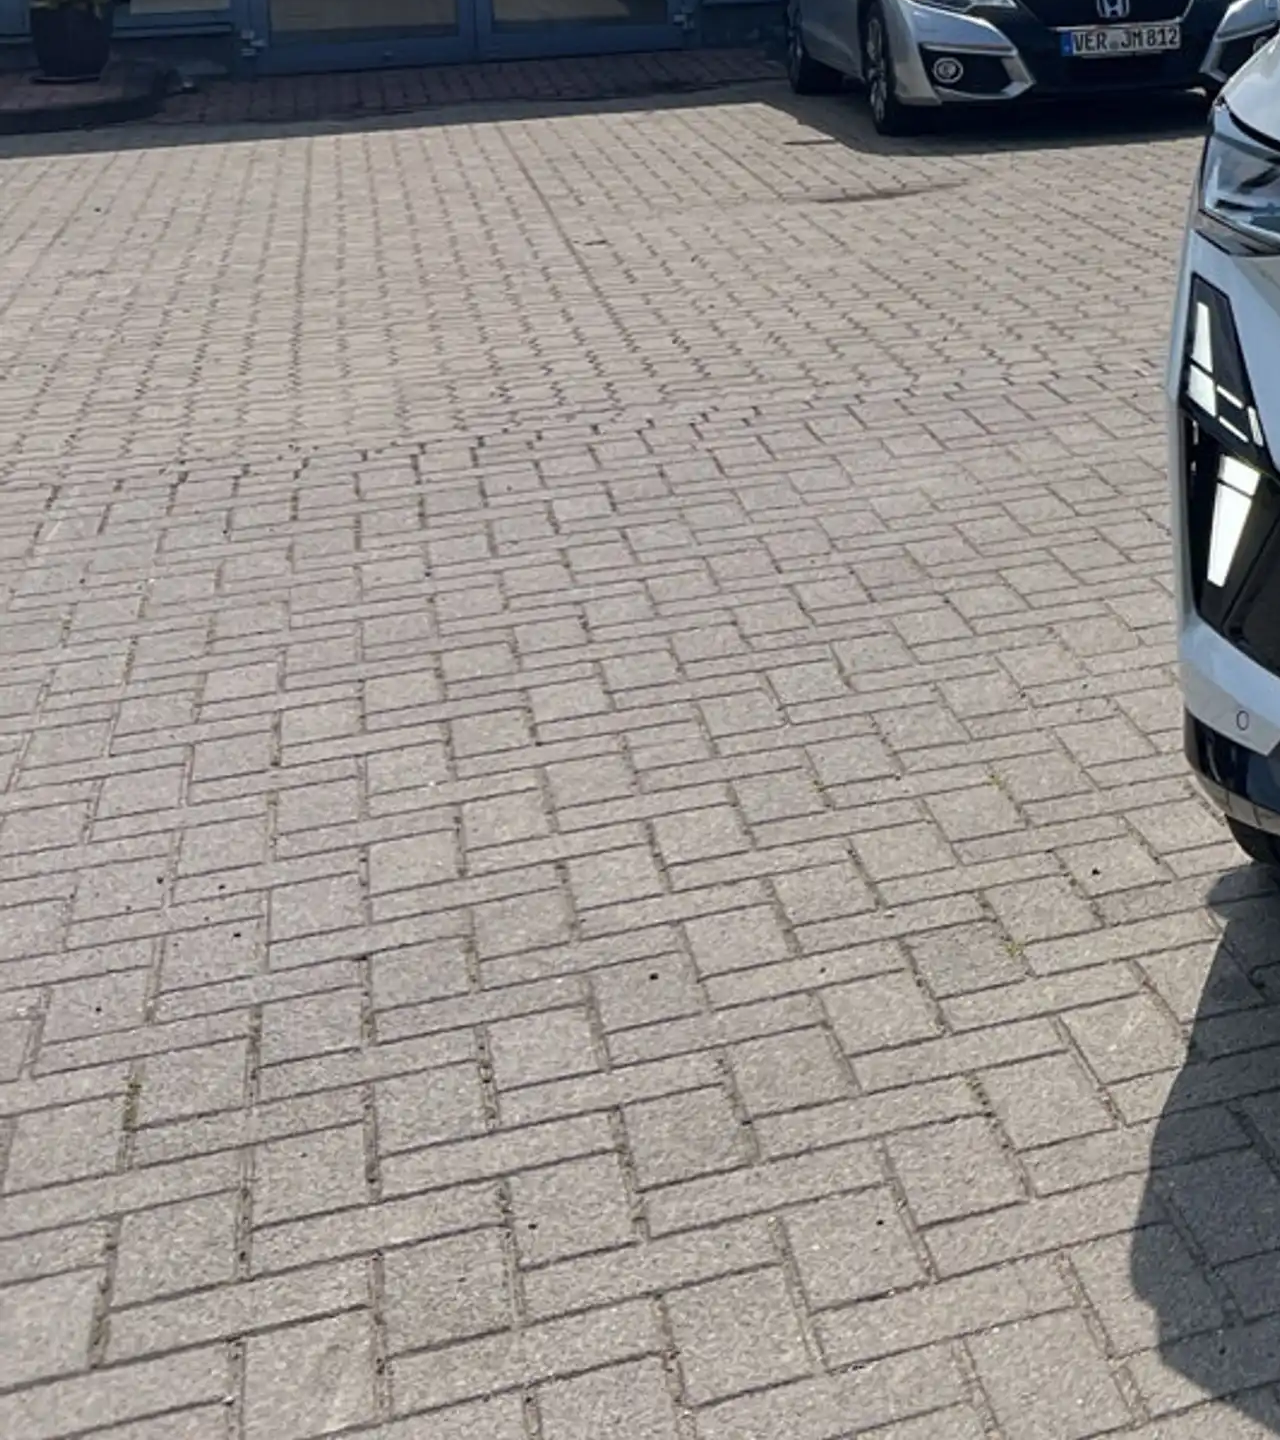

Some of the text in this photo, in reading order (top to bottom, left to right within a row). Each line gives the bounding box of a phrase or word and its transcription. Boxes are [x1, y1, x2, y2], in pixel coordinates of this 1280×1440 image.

[1073, 26, 1178, 52] VER JM 812
